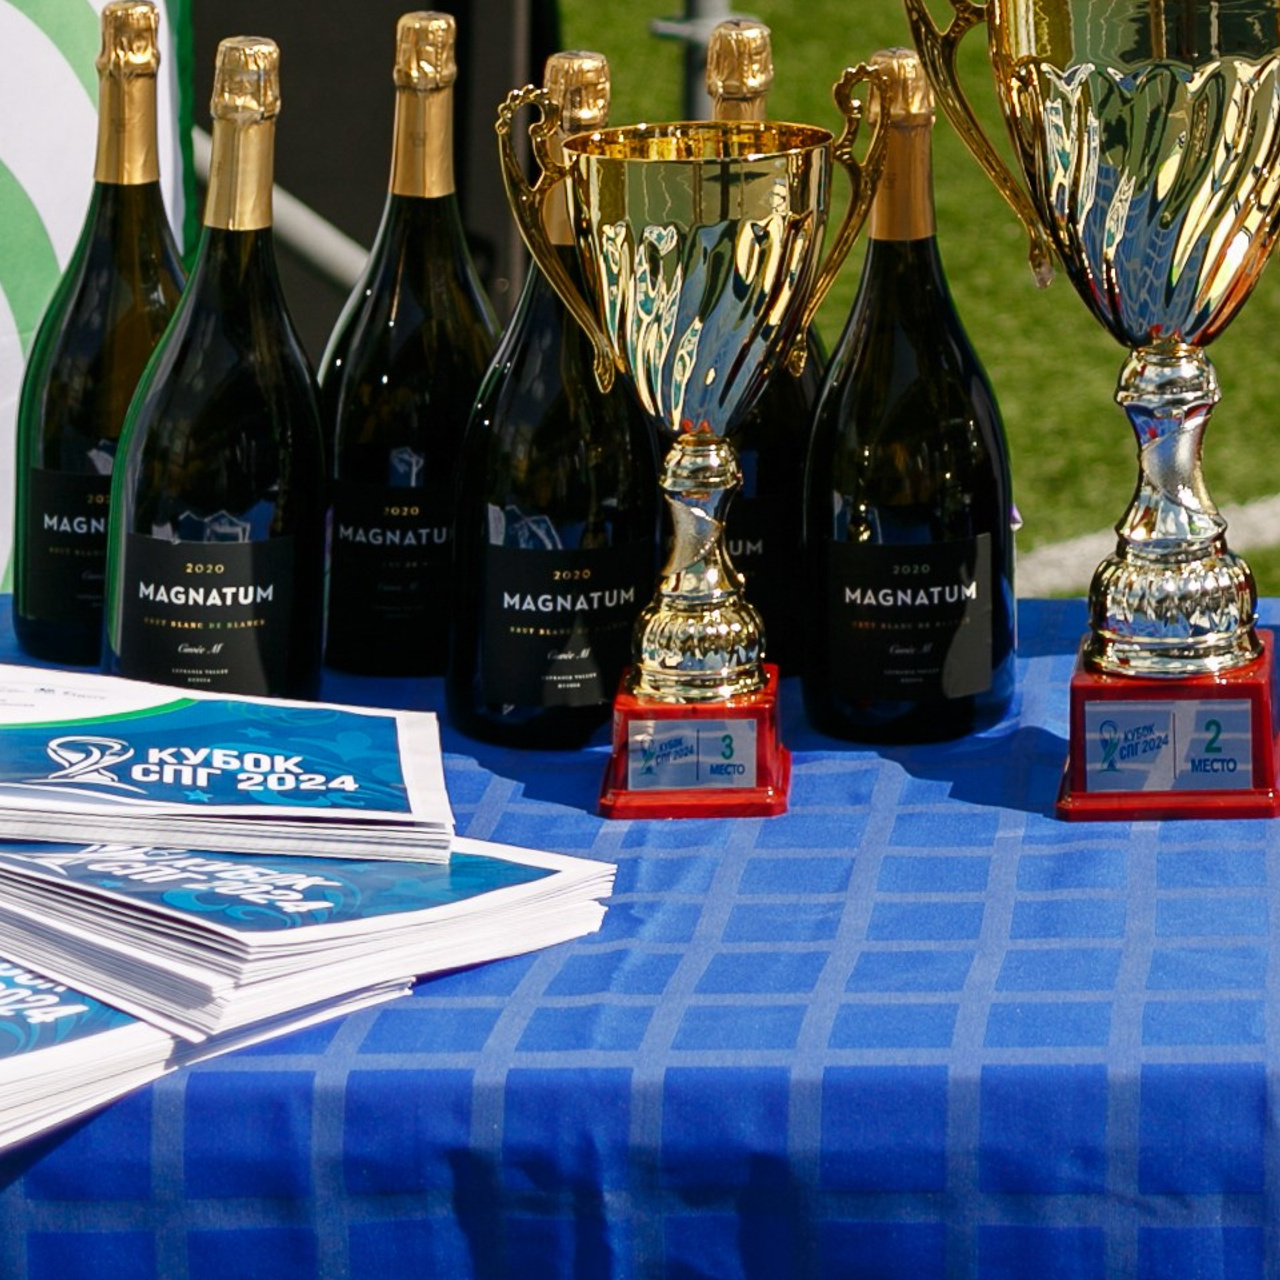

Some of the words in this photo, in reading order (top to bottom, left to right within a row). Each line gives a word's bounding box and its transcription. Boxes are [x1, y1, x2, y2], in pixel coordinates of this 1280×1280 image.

[44, 513, 106, 534] MAGN
[384, 506, 420, 516] 2020
[339, 524, 447, 545] MAGNATU
[186, 563, 225, 574] 2020
[554, 570, 591, 580] 2020
[893, 564, 930, 574] 2020
[139, 581, 274, 607] MAGNATUM
[503, 586, 635, 612] MAGNATUM
[845, 581, 977, 606] MAGNATUM
[1123, 723, 1156, 743] КУБОК
[1204, 719, 1223, 753] 2
[721, 734, 734, 760] 3
[1119, 742, 1141, 761] СПГ
[1142, 734, 1170, 753] 2024
[148, 748, 304, 773] КУБОК
[709, 763, 746, 776] МЕСТО
[1190, 758, 1238, 773] МЕСТО
[131, 764, 222, 787] СПГ
[236, 773, 359, 791] 2024
[159, 857, 342, 890] КУБОК
[87, 861, 207, 883] СПГ
[181, 880, 334, 913] 2024
[0, 982, 90, 1023] 024
